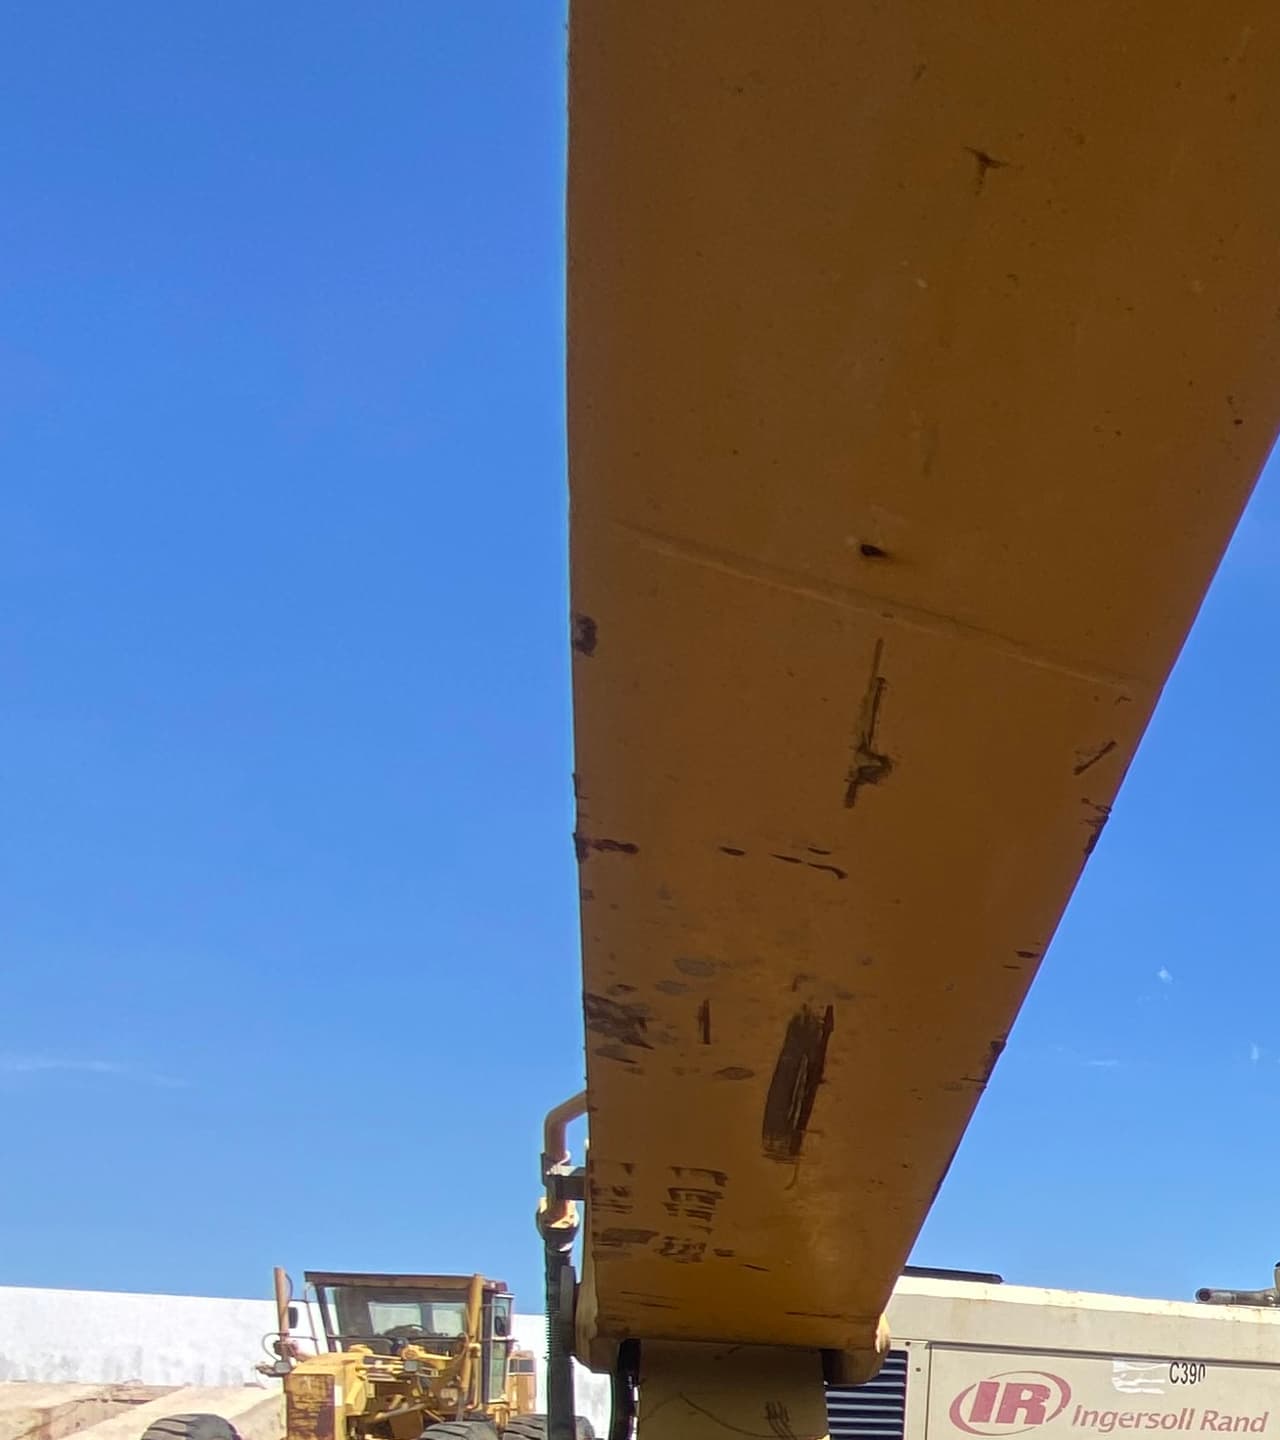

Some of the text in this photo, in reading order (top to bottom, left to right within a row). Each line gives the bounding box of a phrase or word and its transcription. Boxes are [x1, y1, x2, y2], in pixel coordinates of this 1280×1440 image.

[968, 1381, 1051, 1426] IR
[1071, 1404, 1270, 1434] Ingersoll Rand
